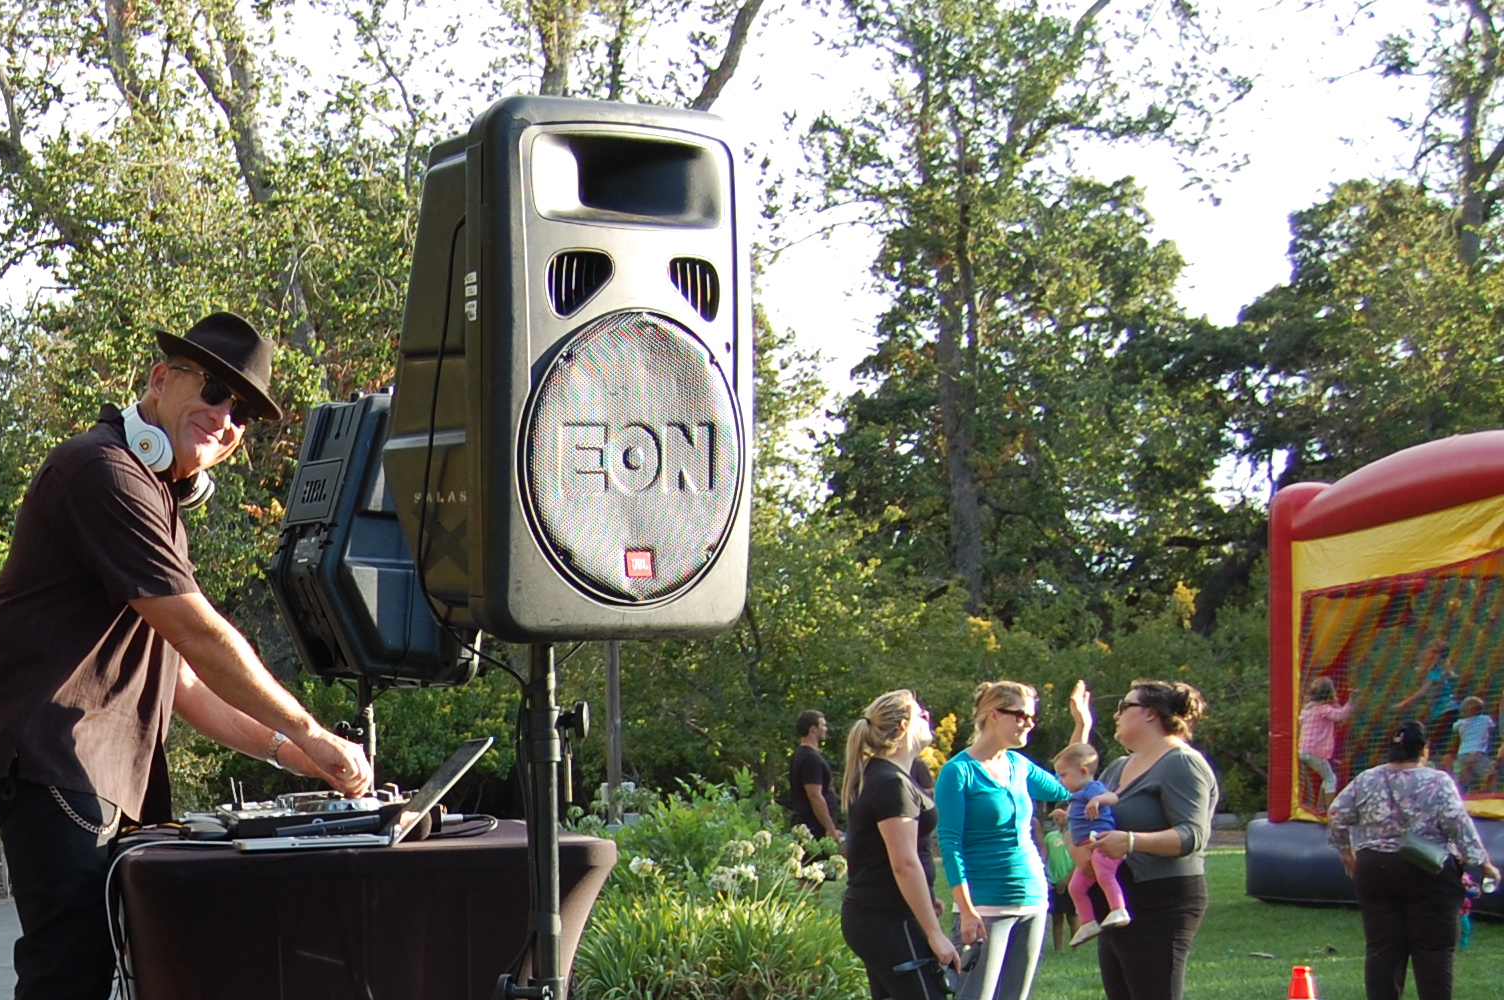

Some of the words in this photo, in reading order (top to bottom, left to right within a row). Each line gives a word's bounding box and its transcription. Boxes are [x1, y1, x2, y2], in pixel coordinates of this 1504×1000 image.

[558, 422, 717, 496] EON
[301, 478, 327, 505] JBL
[631, 558, 649, 570] JBL
